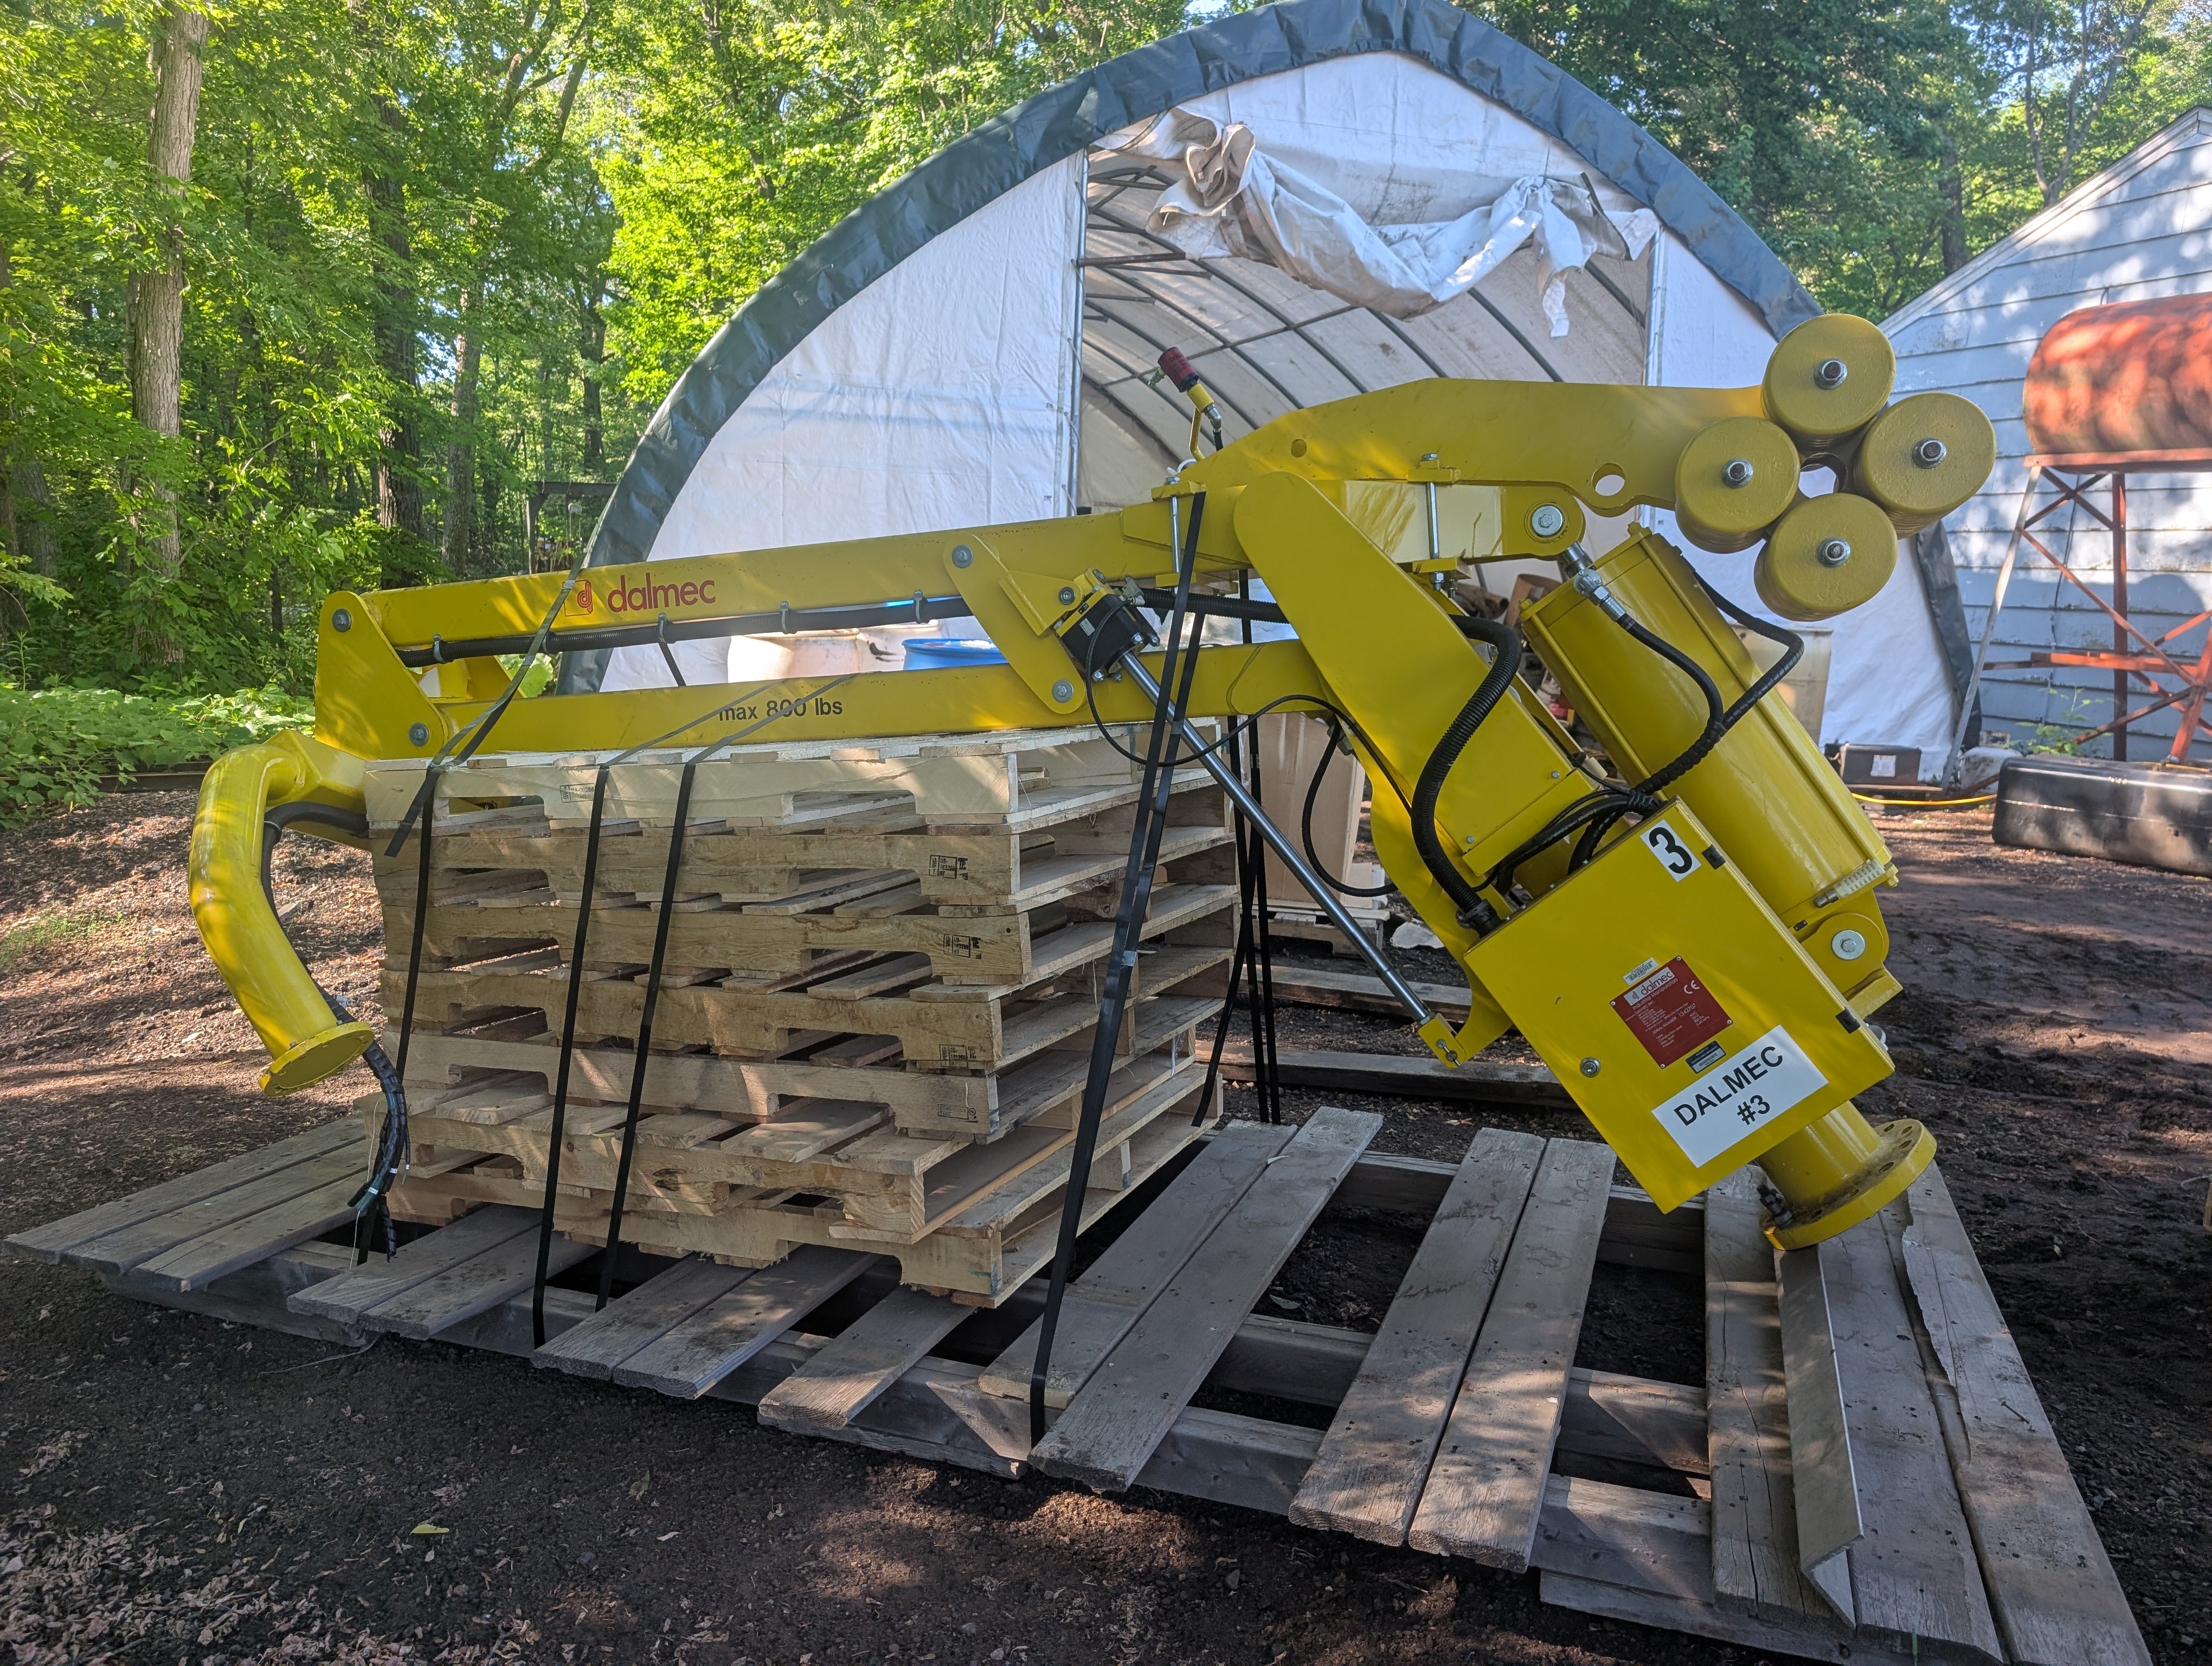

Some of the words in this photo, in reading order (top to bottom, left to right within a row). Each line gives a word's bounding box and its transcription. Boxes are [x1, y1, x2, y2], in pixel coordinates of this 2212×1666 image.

[607, 572, 716, 613] dalmec
[719, 705, 758, 722] max
[767, 699, 807, 717] 800
[815, 697, 843, 716] lbs
[1649, 827, 1693, 874] 3
[1631, 995, 1651, 1010] Industrial
[1651, 978, 1679, 997] Manipulators
[1641, 971, 1673, 996] dalmec
[1652, 1025, 1663, 1034] SERIAL
[1662, 1016, 1677, 1028] NUMBER
[1678, 1003, 1696, 1017] 1342707
[1673, 1046, 1784, 1126] DALMEC
[1737, 1094, 1770, 1126] #3
